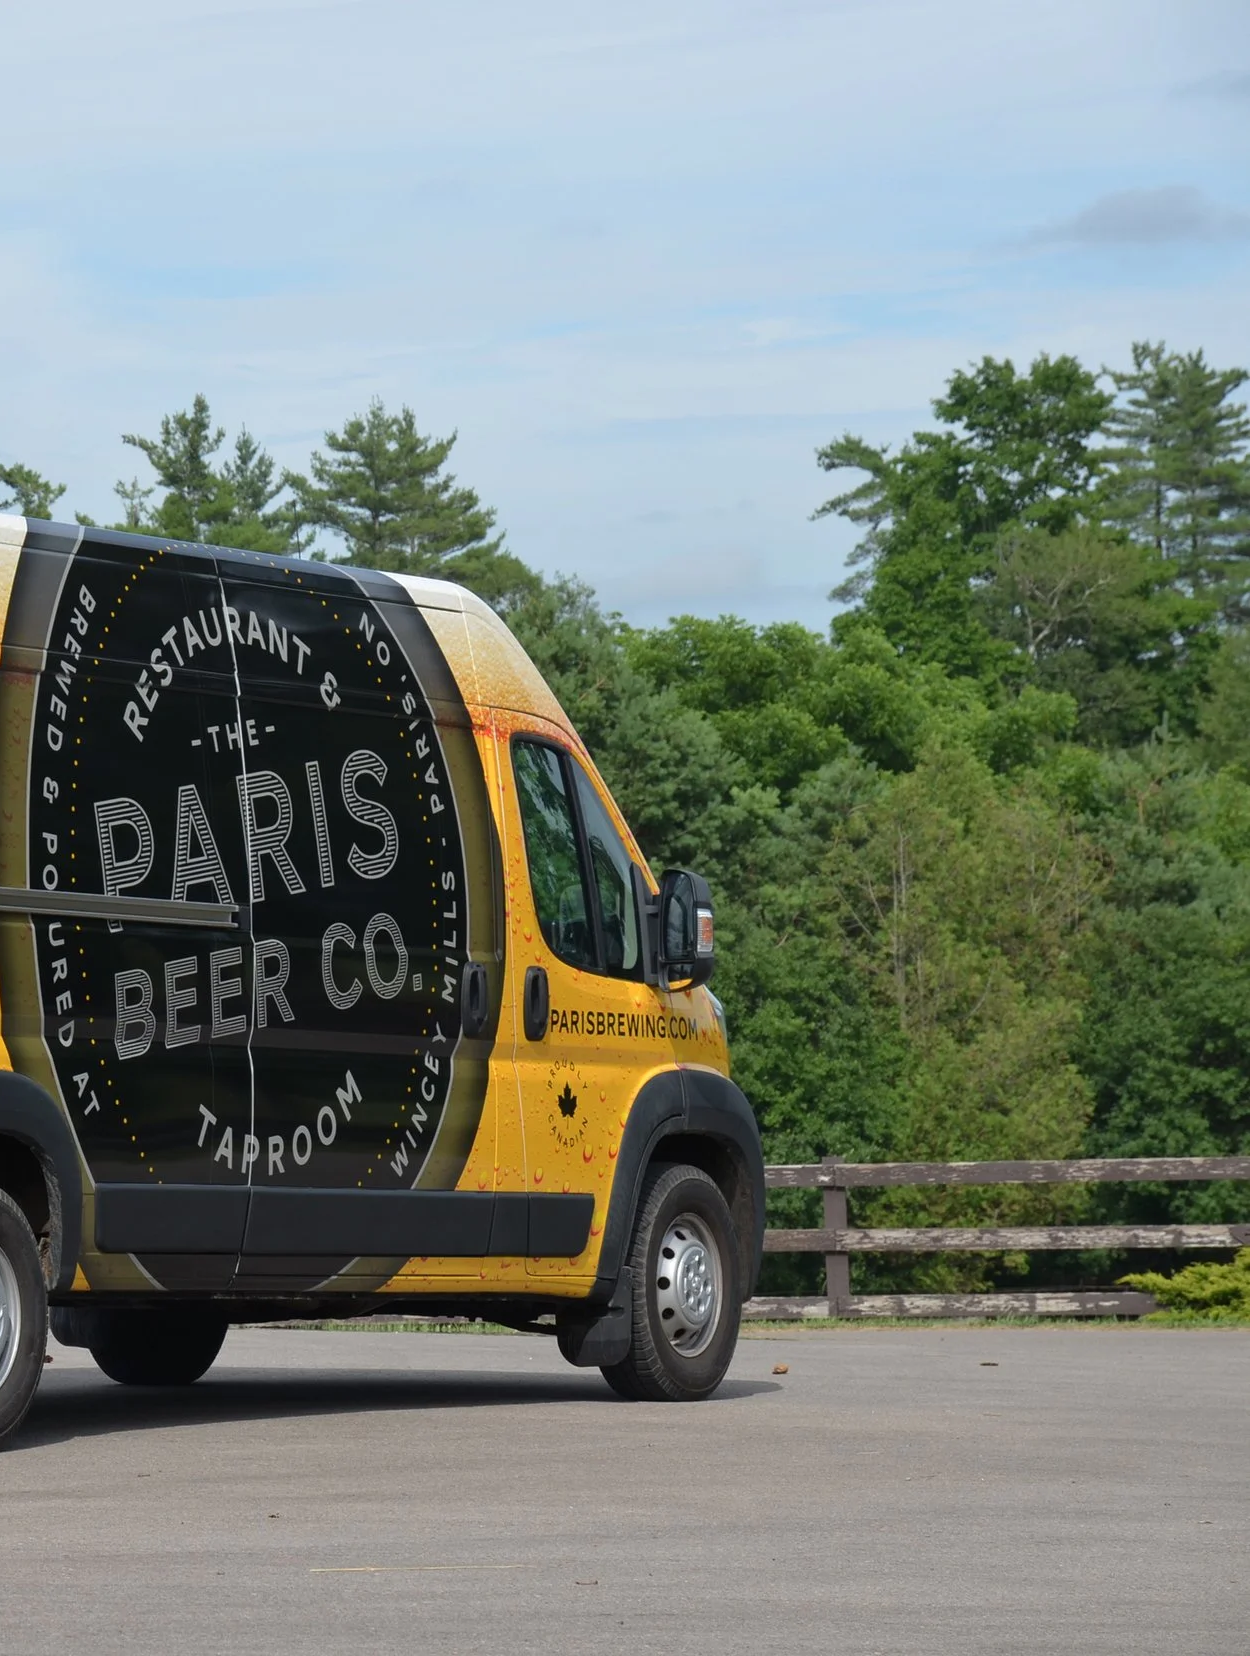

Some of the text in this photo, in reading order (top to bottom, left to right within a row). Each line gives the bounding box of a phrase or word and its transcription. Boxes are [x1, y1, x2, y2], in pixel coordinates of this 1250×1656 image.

[123, 606, 341, 742] RESTAURANT &
[359, 612, 391, 666] ON
[401, 674, 445, 814] PARIS,
[42, 584, 101, 1116] BREWED & POURED AT
[94, 749, 399, 933] PARIS
[114, 912, 423, 1060] BEER CO.
[442, 870, 459, 1004] MILLS
[547, 1057, 589, 1090] PROUDLY
[550, 1009, 699, 1042] PARISBREWING.COM
[197, 1069, 364, 1176] TAPROOM
[390, 1021, 448, 1177] WINCEY
[548, 1113, 589, 1148] CANADIAN
